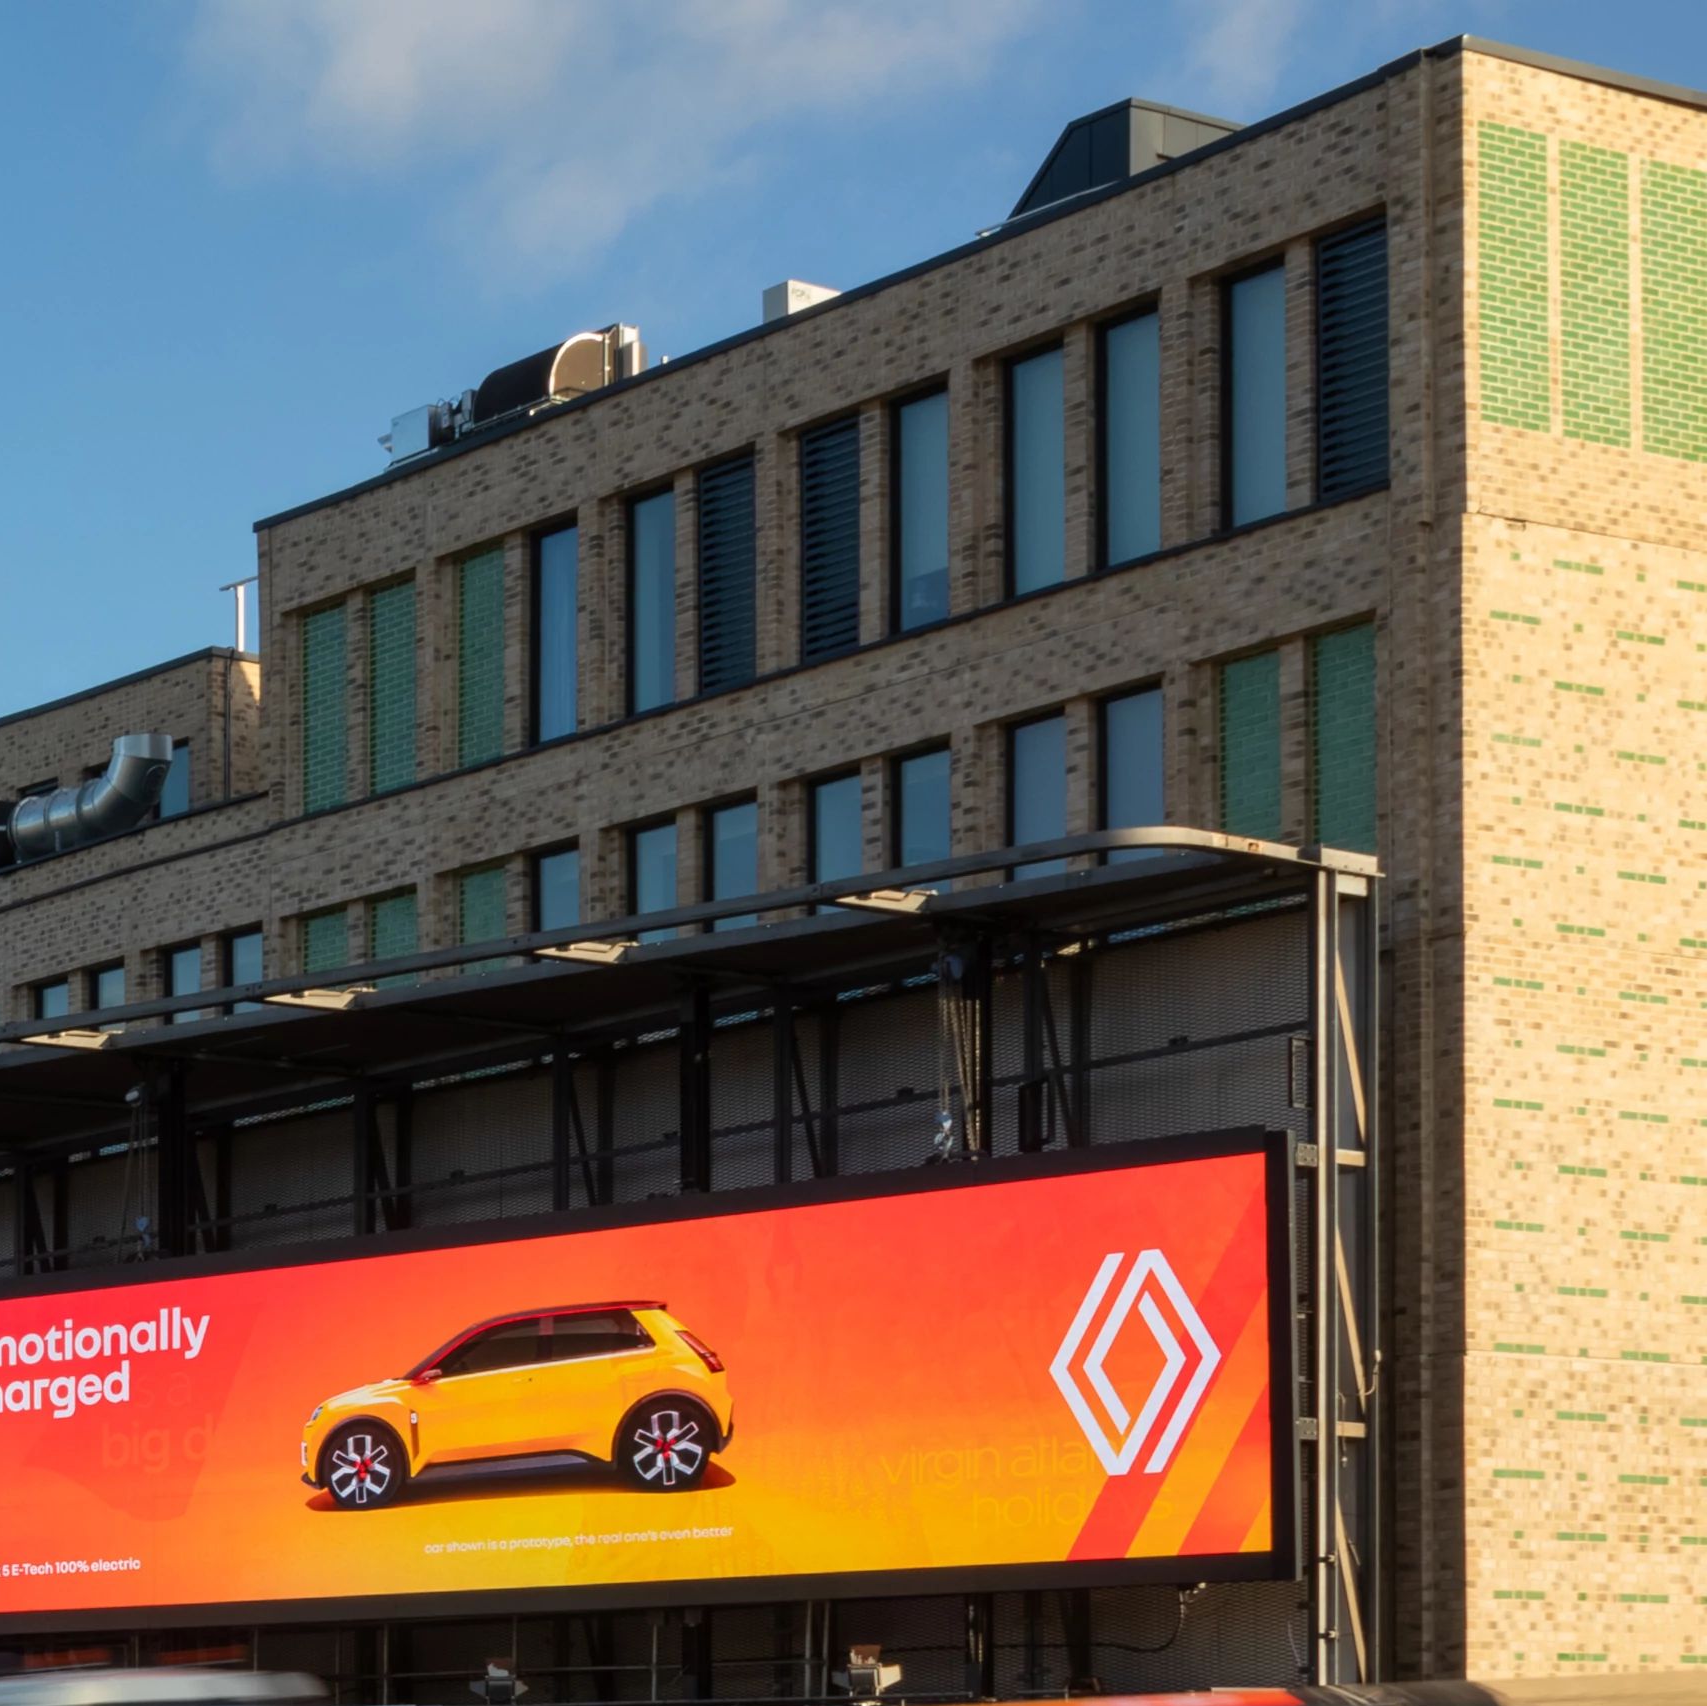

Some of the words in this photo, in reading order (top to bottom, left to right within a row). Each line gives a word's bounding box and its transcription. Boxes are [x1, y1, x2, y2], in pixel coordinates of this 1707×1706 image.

[424, 1543, 445, 1554] car
[446, 1541, 485, 1553] shown
[488, 1539, 497, 1551] is
[574, 1533, 595, 1546] the
[598, 1532, 622, 1544] real
[659, 1528, 691, 1541] even
[692, 1526, 734, 1539] better
[2, 1565, 10, 1577] 5
[11, 1562, 53, 1576] E-Tech
[55, 1560, 89, 1574] 100%
[90, 1557, 141, 1572] electric
